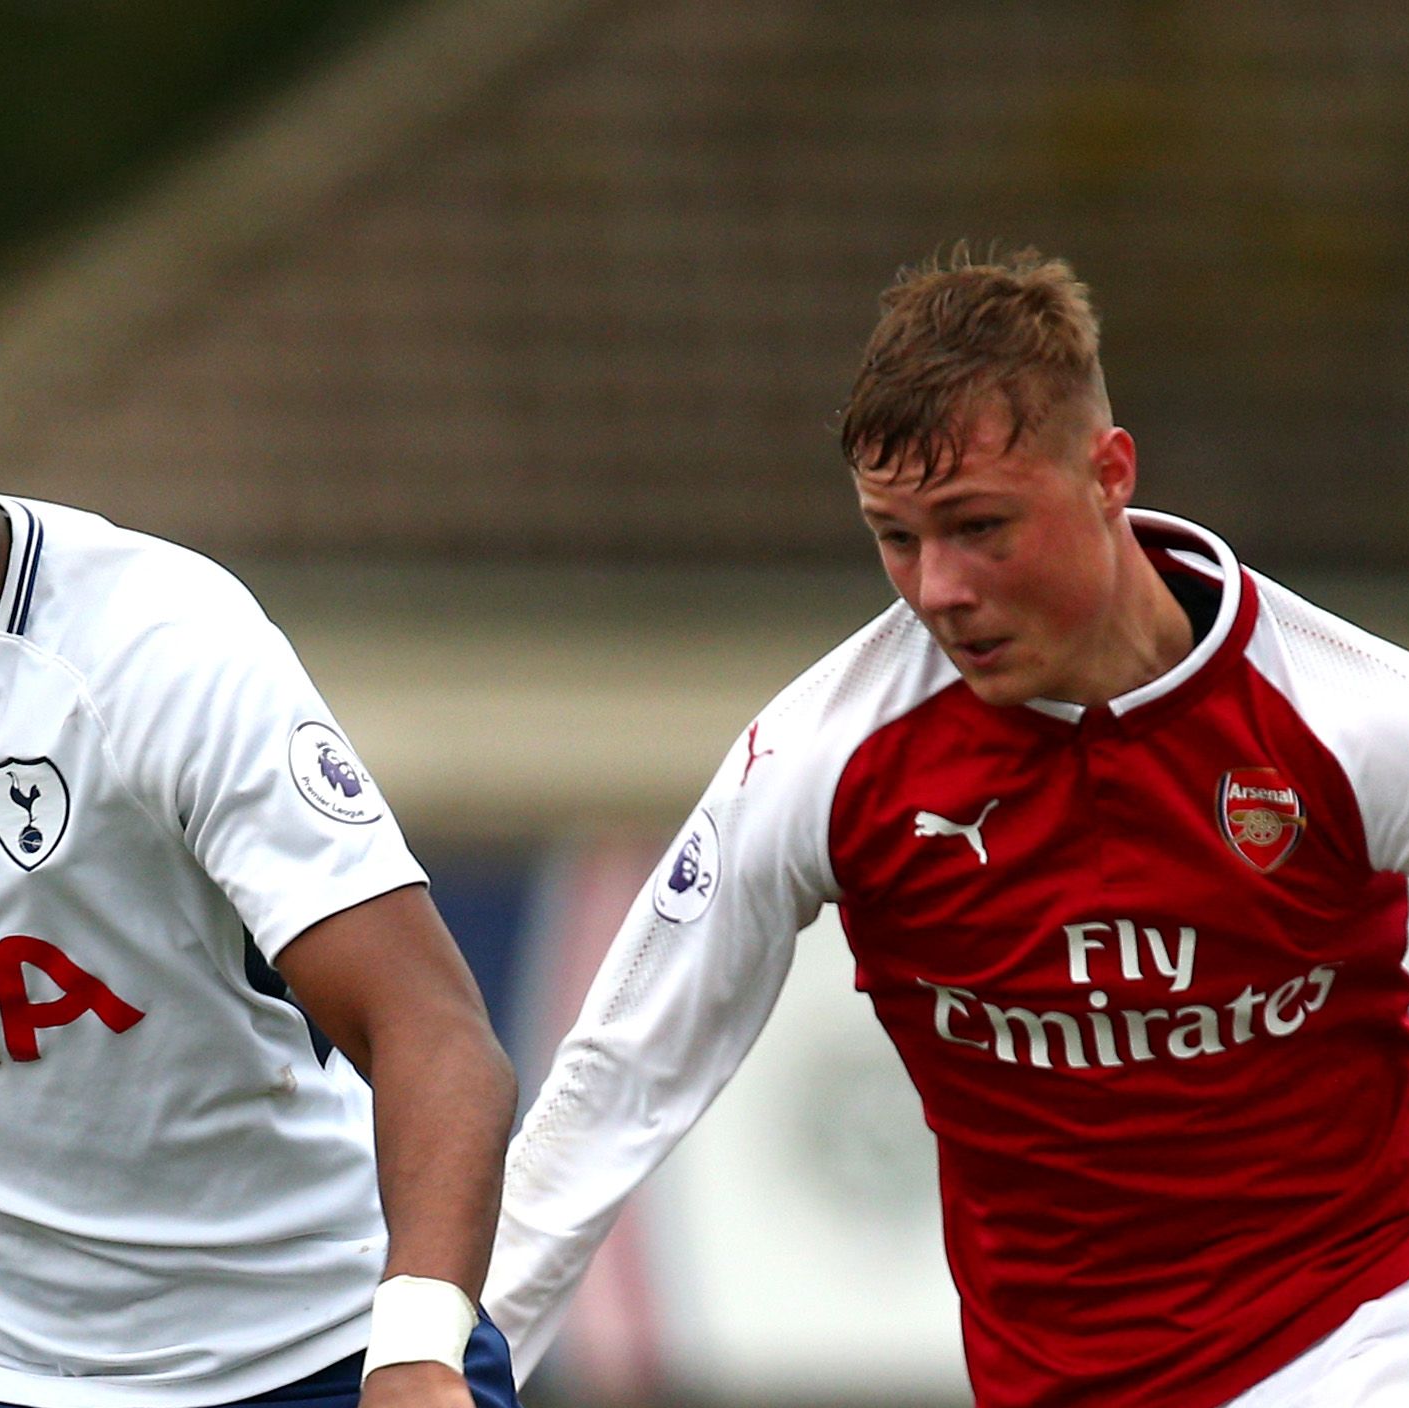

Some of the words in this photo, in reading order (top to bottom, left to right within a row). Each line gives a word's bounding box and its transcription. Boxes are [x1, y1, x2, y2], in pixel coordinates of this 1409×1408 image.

[1229, 783, 1295, 804] Arsenal
[697, 872, 712, 898] 2
[1062, 918, 1197, 992] Fly
[916, 961, 1344, 1070] Emirates
